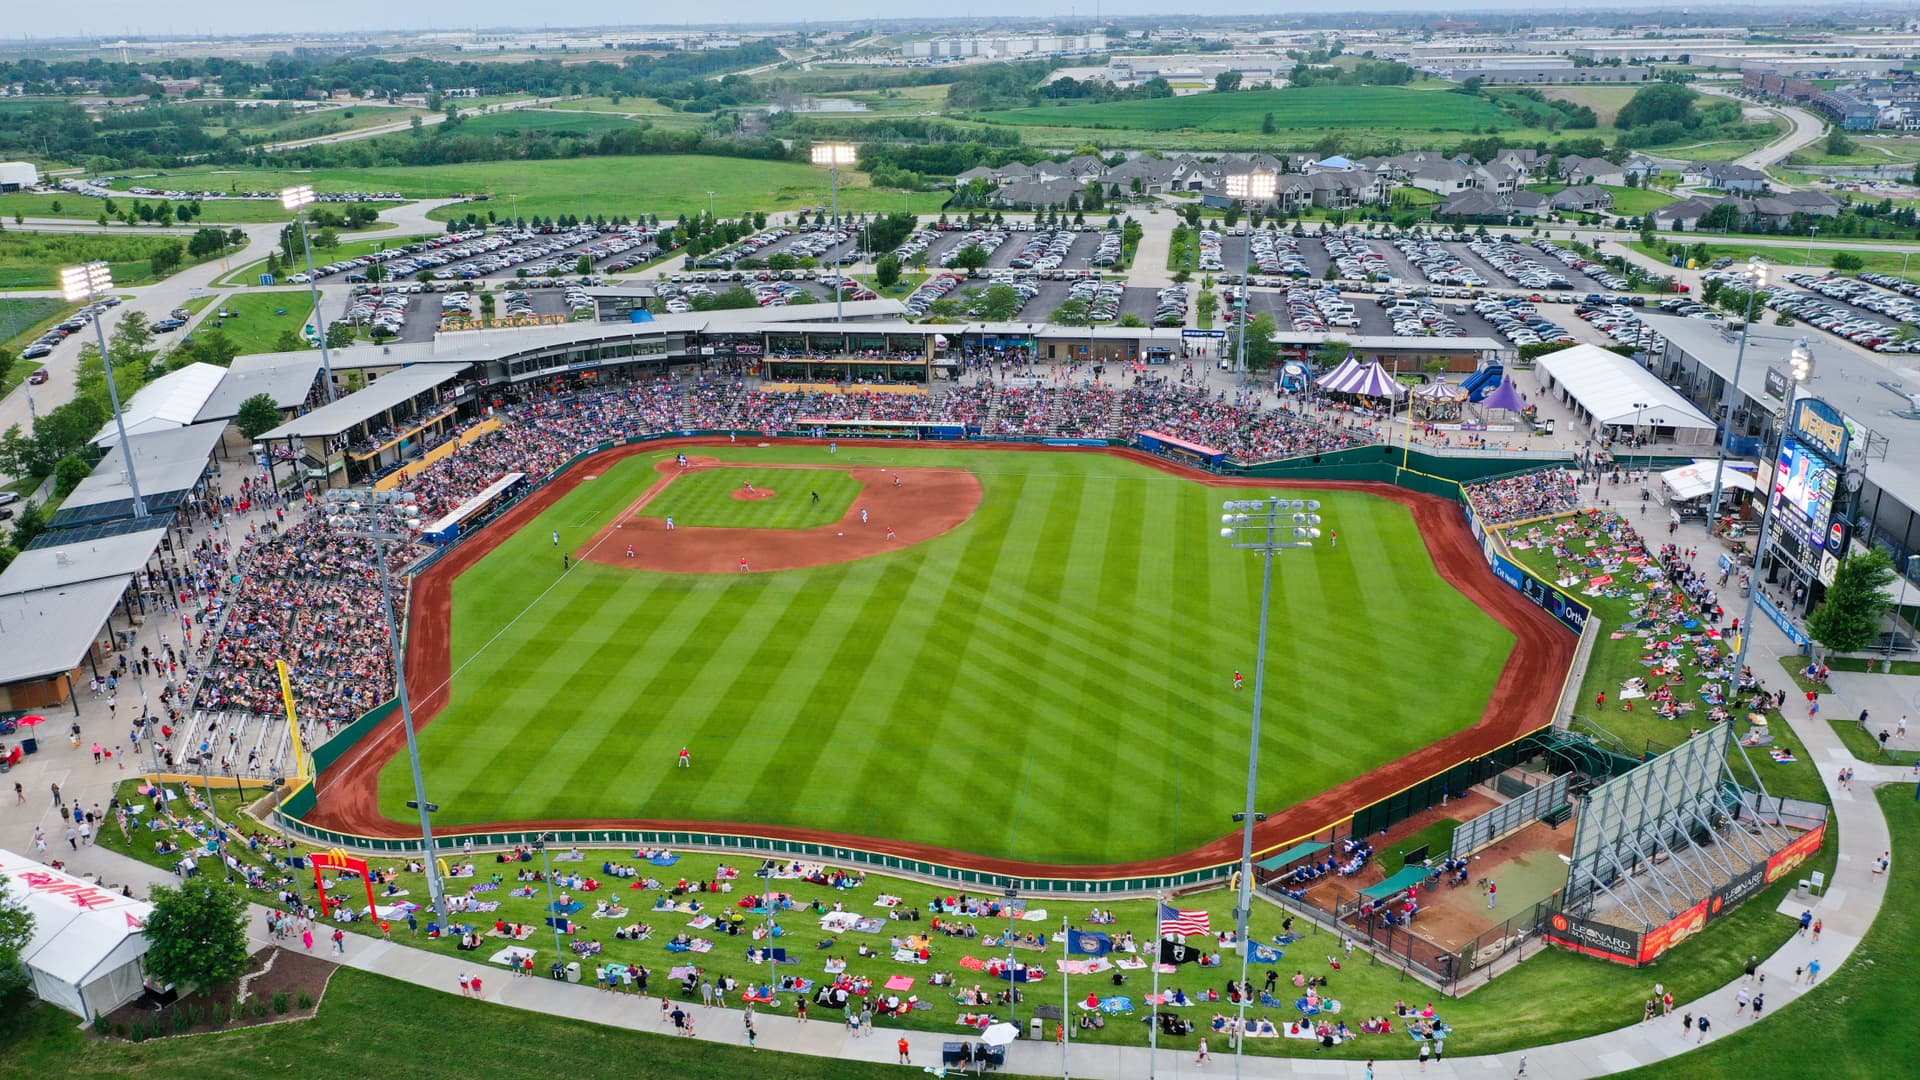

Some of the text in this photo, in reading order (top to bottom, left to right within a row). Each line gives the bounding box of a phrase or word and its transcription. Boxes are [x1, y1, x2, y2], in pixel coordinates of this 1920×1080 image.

[1799, 402, 1844, 456] WERNER
[1725, 871, 1762, 899] LEONARD
[1570, 930, 1630, 955] MANAGEMENT
[1571, 922, 1631, 950] LEONARD
